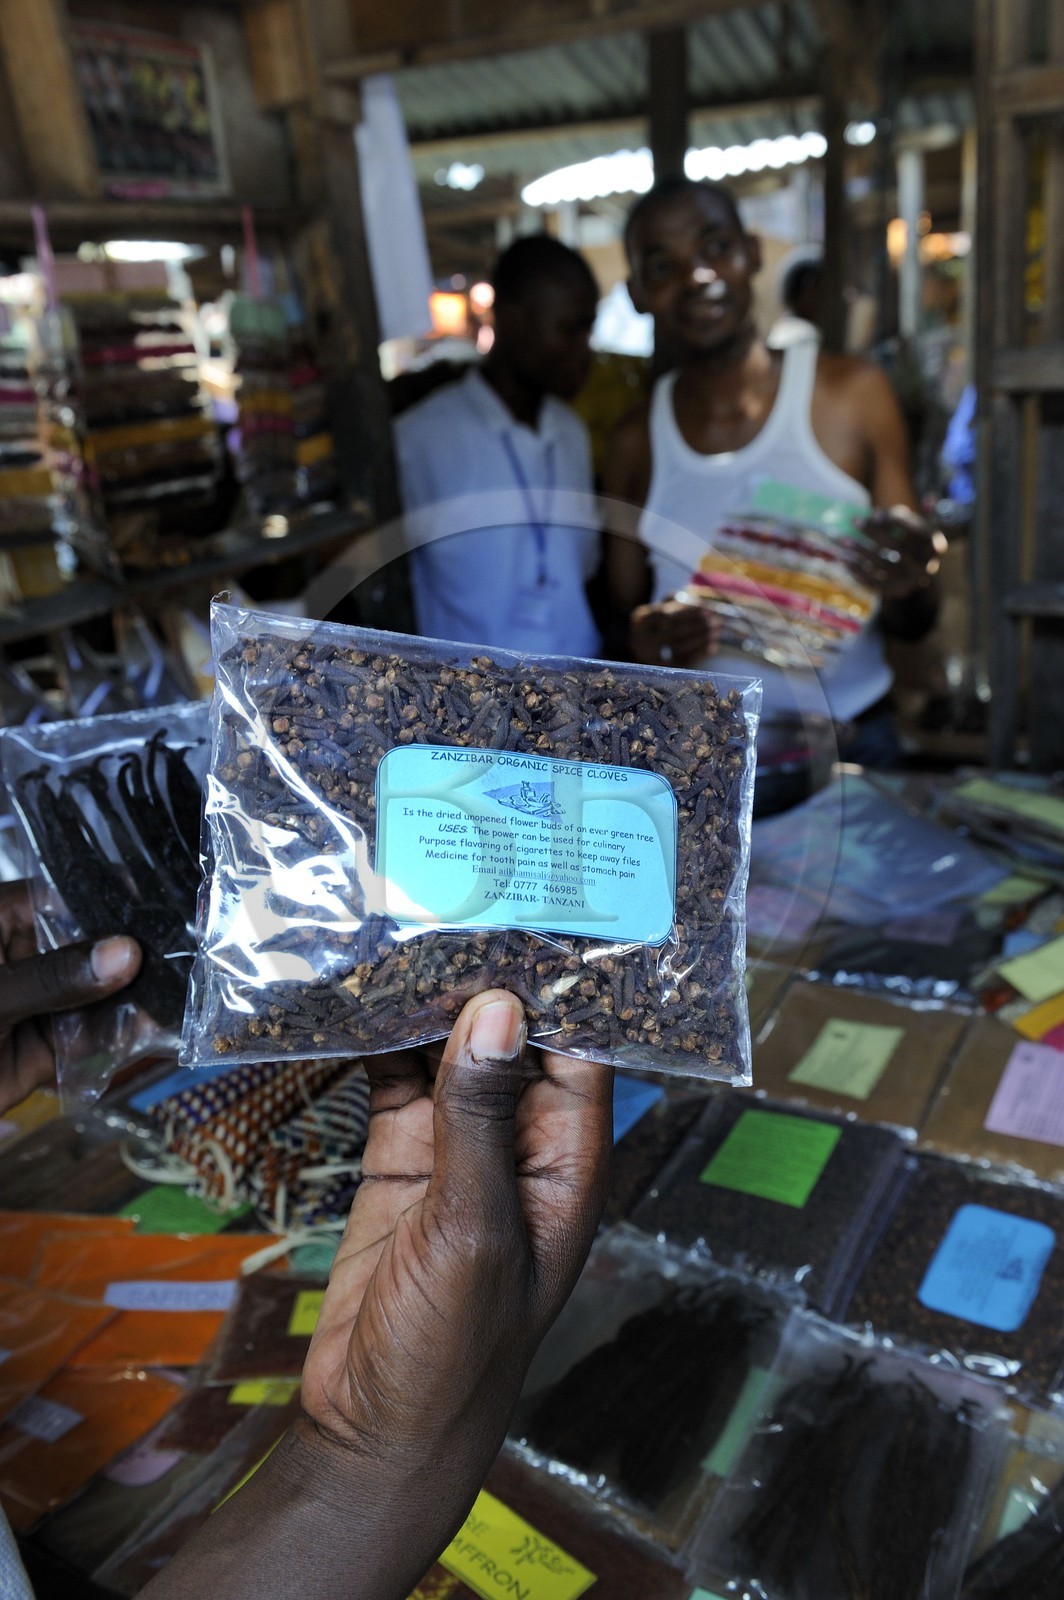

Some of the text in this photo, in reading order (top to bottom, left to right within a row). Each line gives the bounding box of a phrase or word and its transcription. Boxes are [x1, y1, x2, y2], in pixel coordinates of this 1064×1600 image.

[431, 751, 628, 782] ZANZIBAR ORGANIC SPICE CLOVES
[403, 807, 654, 843] Is the dried unopened flower buds of an ever green tree
[471, 826, 490, 836] The
[492, 830, 519, 840] power
[521, 832, 537, 841] can
[539, 833, 551, 843] be
[553, 834, 574, 845] used
[576, 836, 591, 847] for
[592, 838, 626, 854] culinary
[419, 835, 641, 867] Purpose flavoring of cigarettes to keep away files
[425, 849, 636, 879] Medicine for tooth pain as well as stomach pain
[472, 865, 497, 875] Email
[493, 878, 578, 895] Tel: 0777 466985
[452, 1537, 531, 1600] AFFRON
